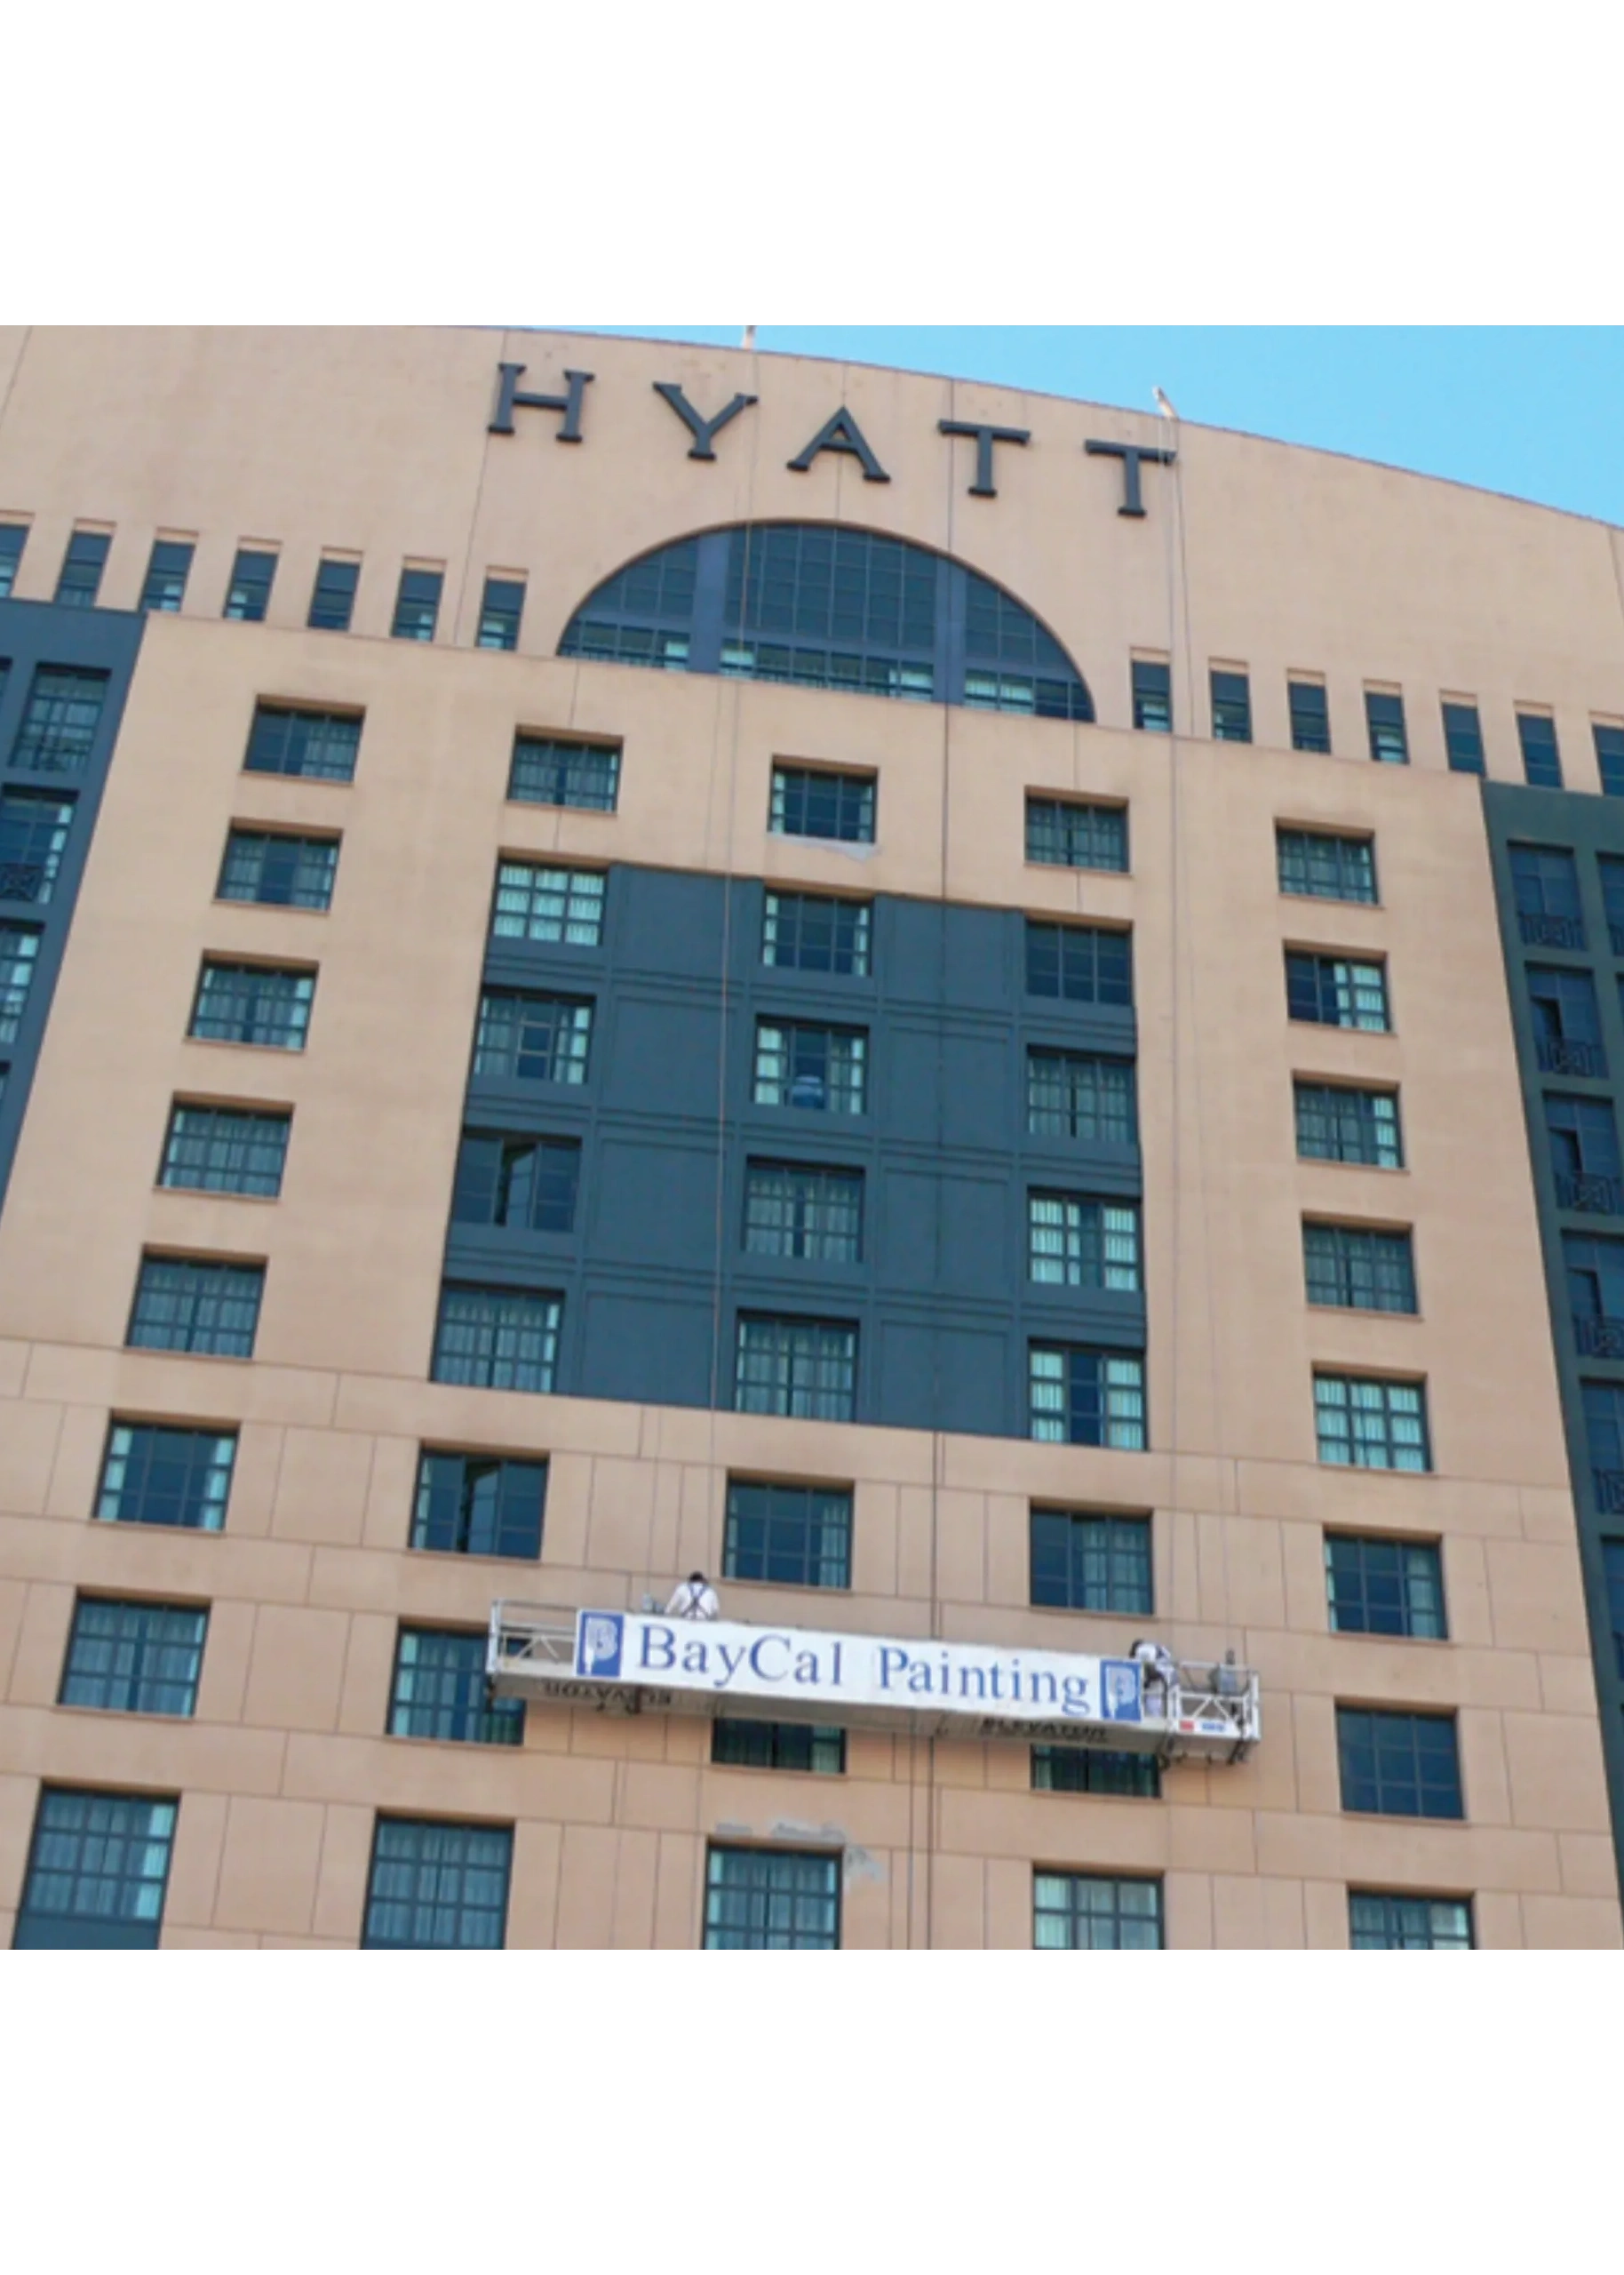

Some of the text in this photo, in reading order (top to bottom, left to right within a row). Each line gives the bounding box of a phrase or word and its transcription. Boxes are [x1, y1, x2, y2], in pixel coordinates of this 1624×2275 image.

[488, 363, 1177, 518] HYATT
[640, 1624, 842, 1687] BayCal
[879, 1646, 1091, 1716] Painting
